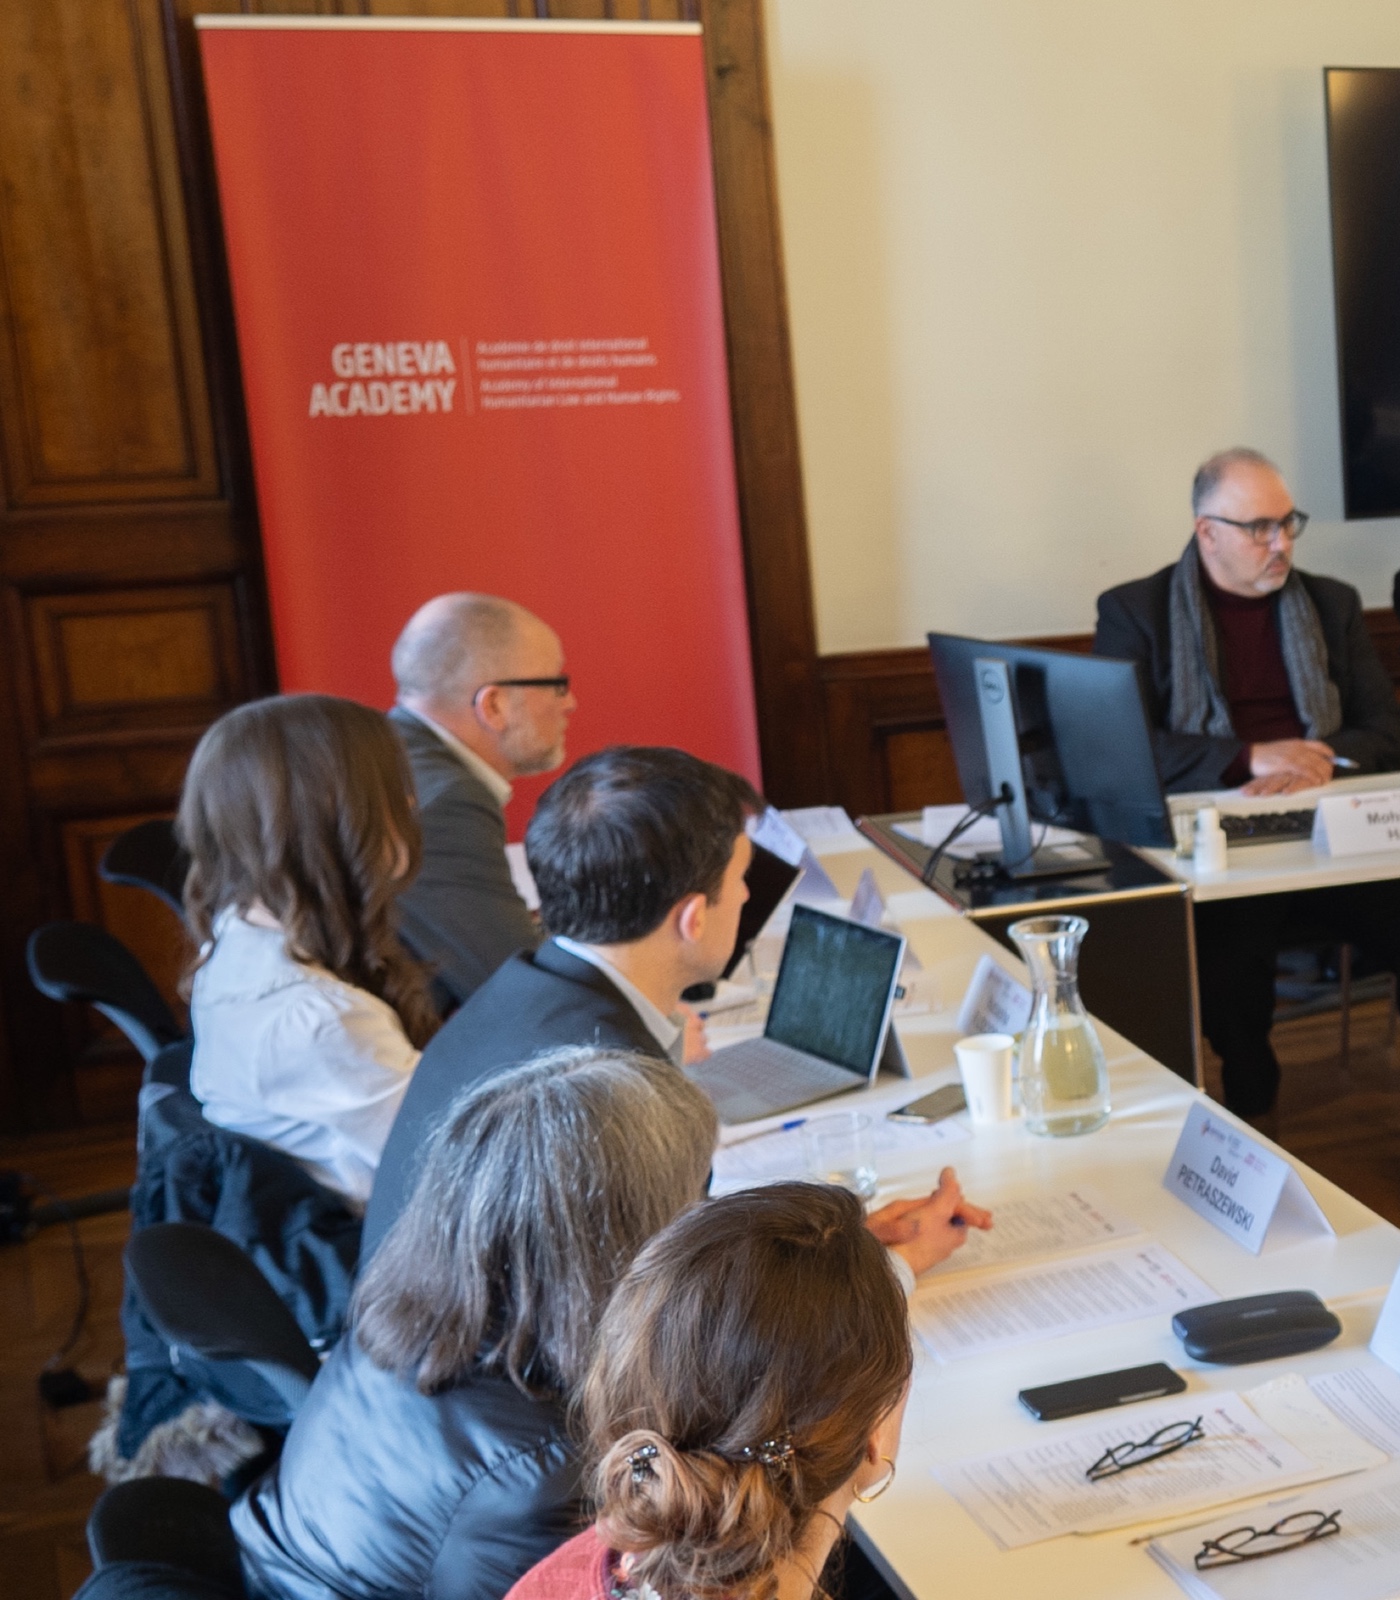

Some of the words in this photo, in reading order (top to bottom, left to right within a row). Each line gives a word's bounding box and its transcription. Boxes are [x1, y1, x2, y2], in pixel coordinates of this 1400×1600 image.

[332, 341, 456, 378] GENEVA
[309, 379, 457, 419] ACADEMY
[1210, 1155, 1240, 1188] David
[1177, 1164, 1255, 1232] PIETRASZEWSKI
